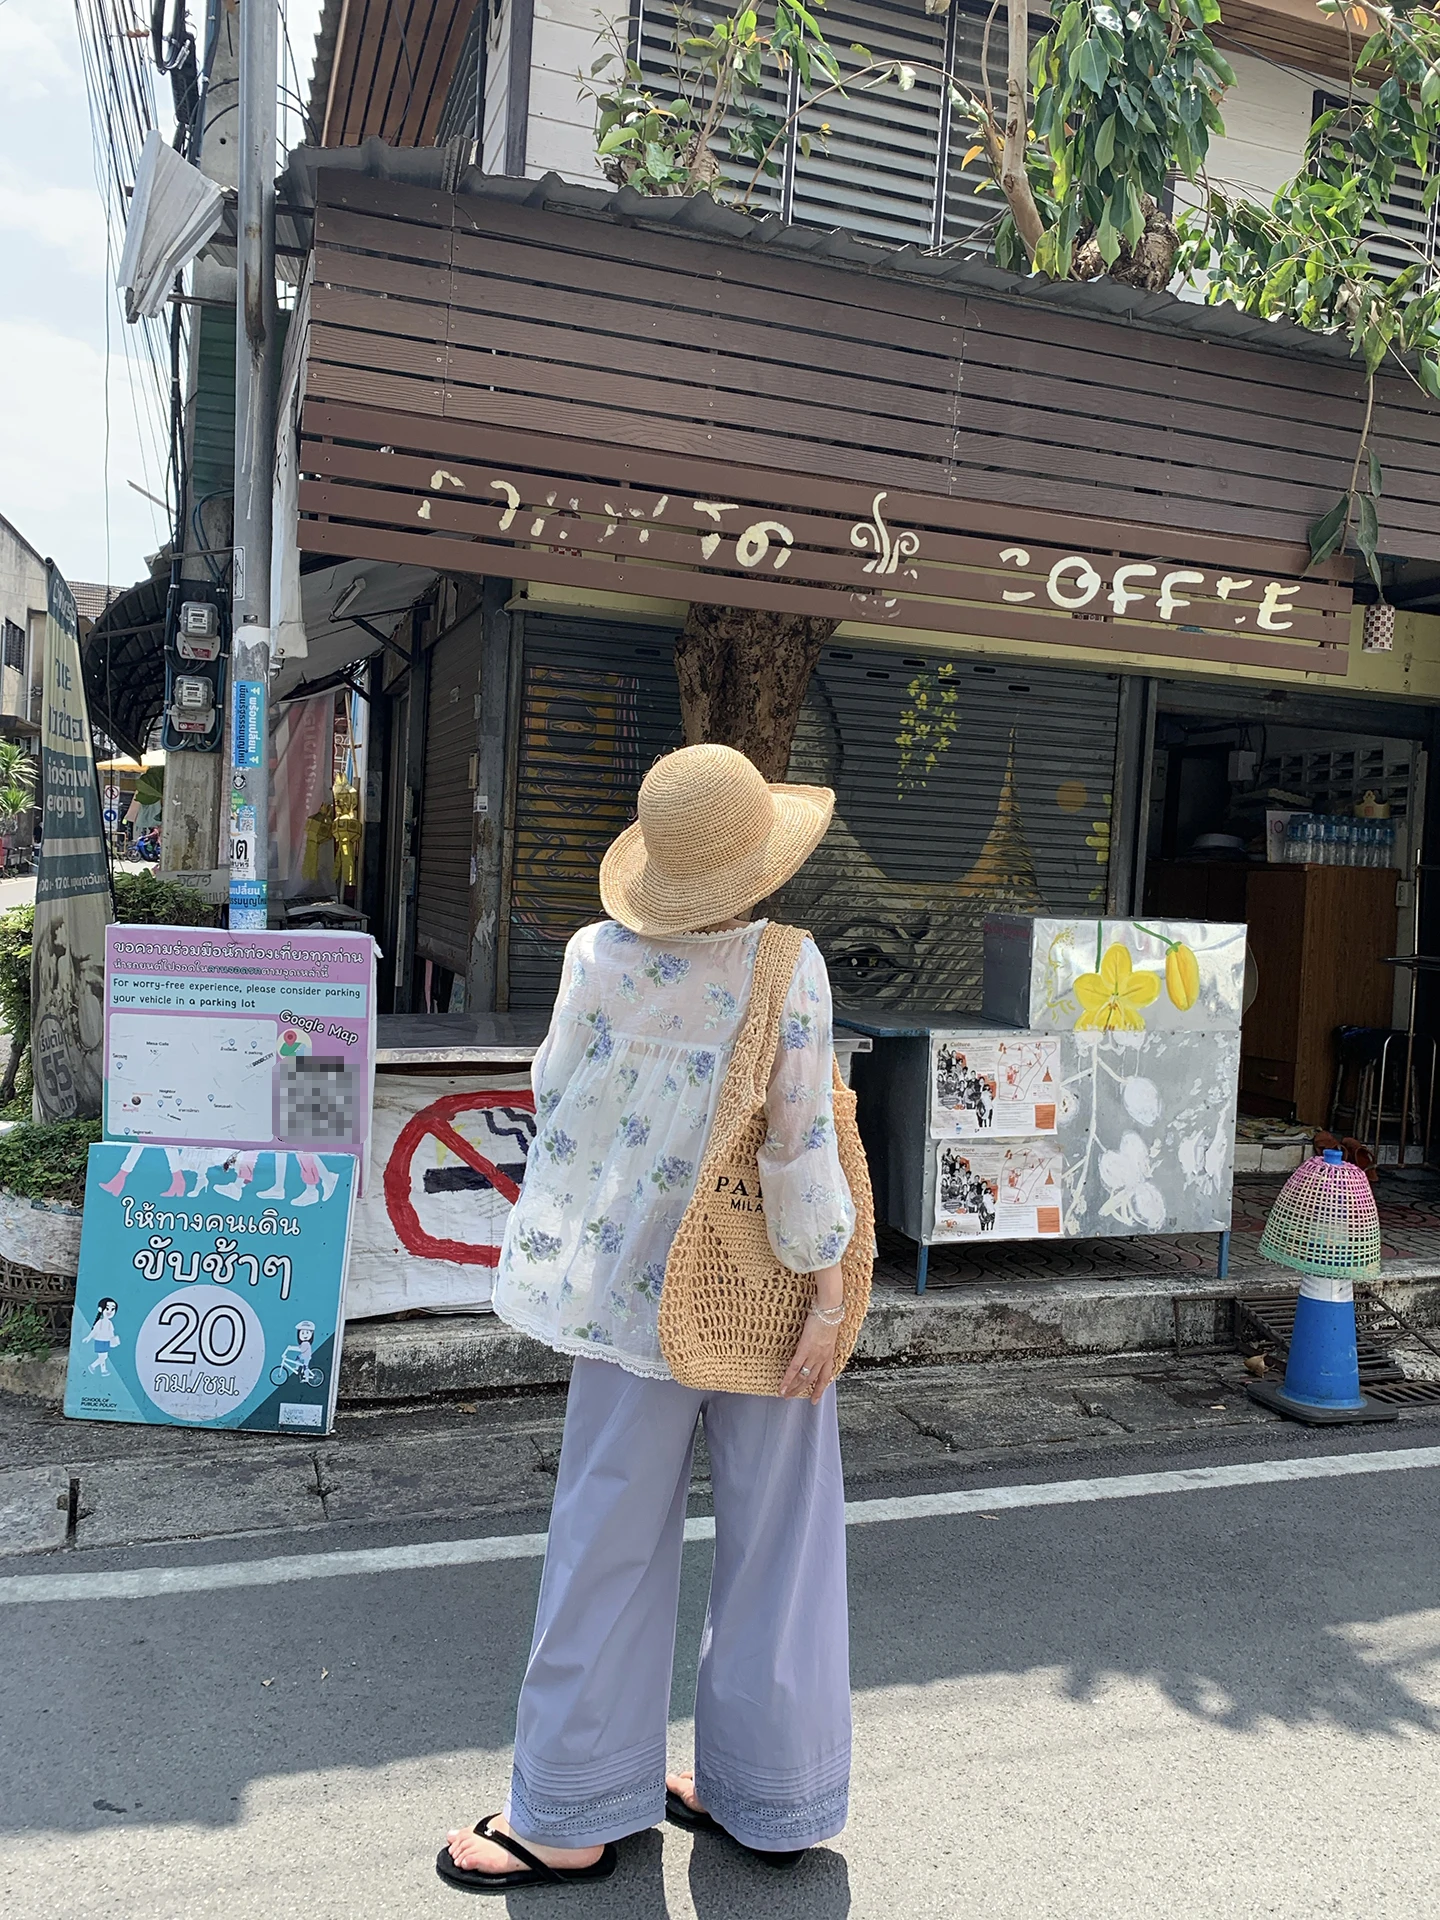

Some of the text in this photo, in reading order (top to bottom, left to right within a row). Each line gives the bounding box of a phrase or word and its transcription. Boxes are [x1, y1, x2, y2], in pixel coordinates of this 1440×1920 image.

[113, 939, 364, 967] ขอความร่วมมือนักท่องเที่ยวทุกท่าน
[113, 978, 361, 999] For worry-free experience, please consider parking
[113, 995, 136, 1004] your
[139, 995, 172, 1005] vehicle
[175, 996, 185, 1005] in
[200, 998, 237, 1010] parking
[241, 999, 256, 1008] lot
[279, 1009, 359, 1046] Google Map
[41, 1049, 72, 1097] 55
[121, 1196, 301, 1236] ให้ทางคนเดิน
[133, 1235, 292, 1301] ขับช้าๆ
[154, 1302, 246, 1367] 20
[154, 1372, 240, 1396] กม./ชม.
